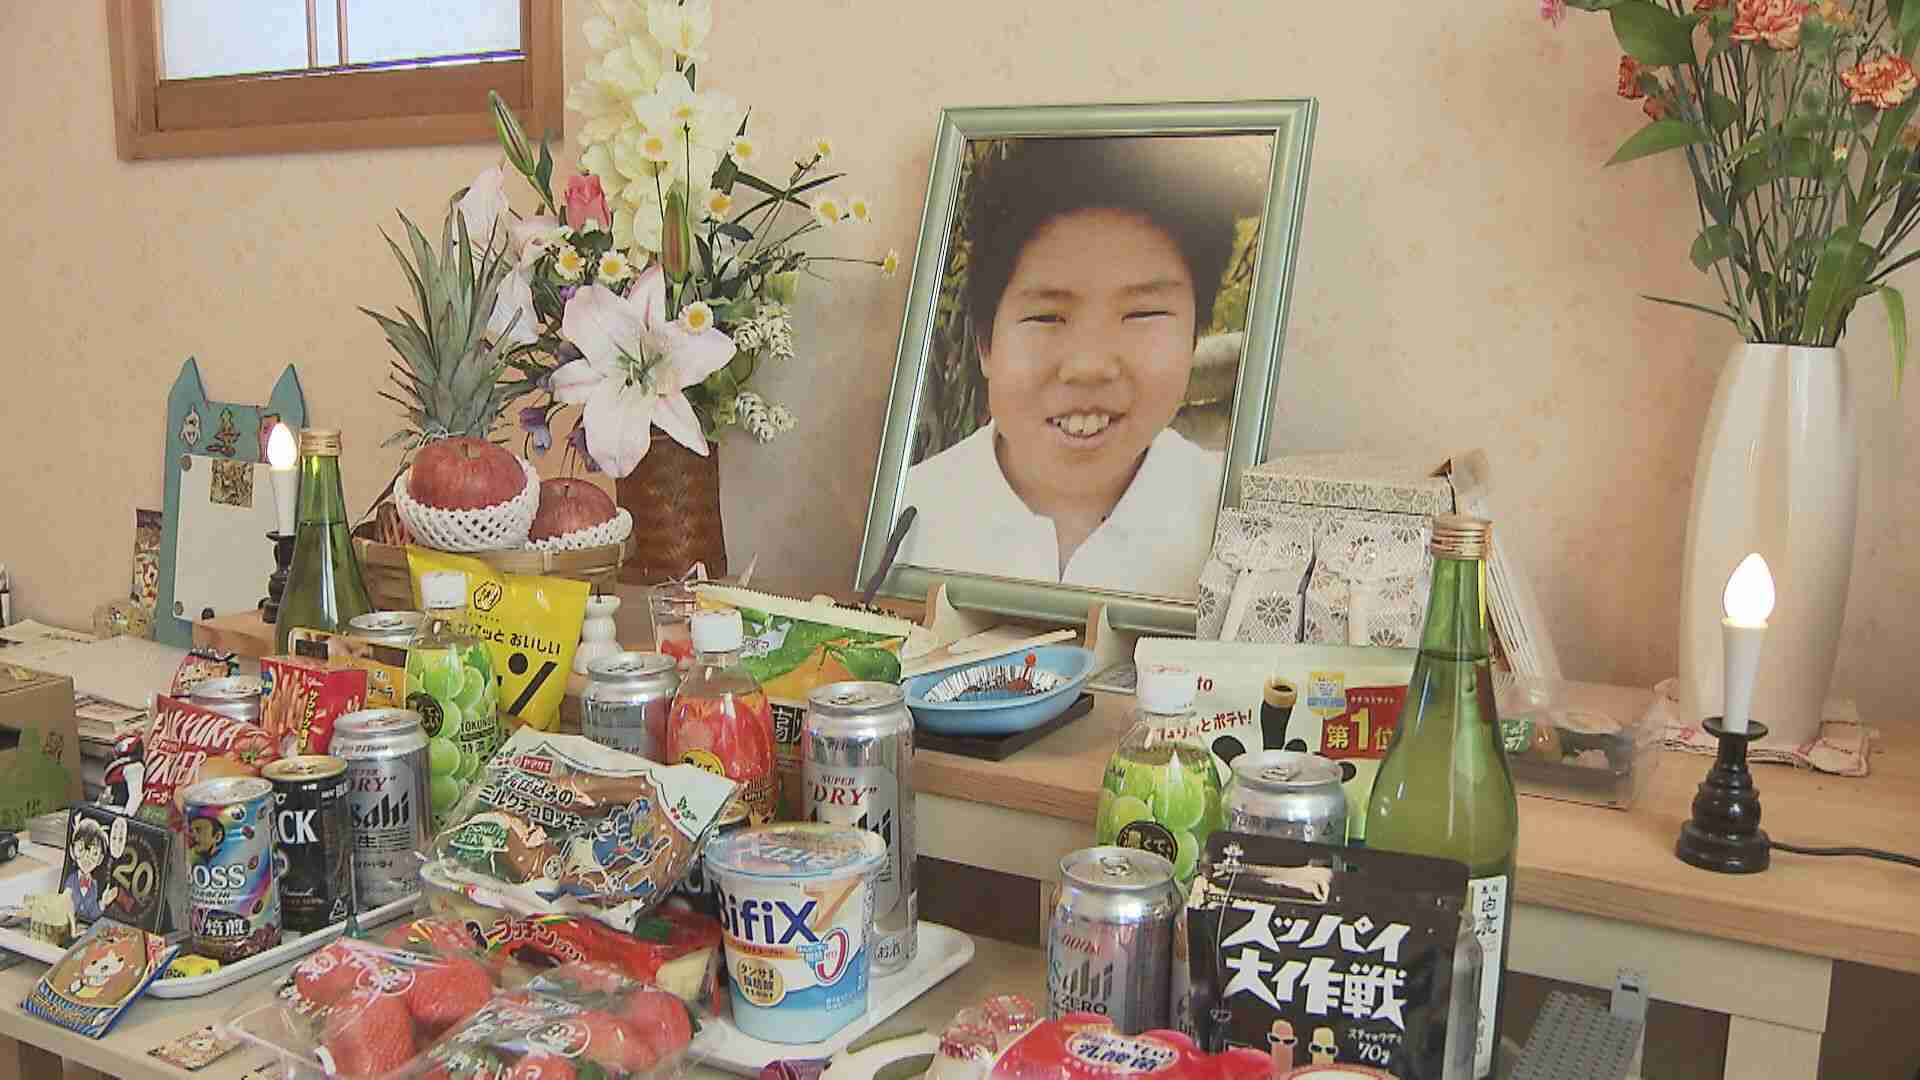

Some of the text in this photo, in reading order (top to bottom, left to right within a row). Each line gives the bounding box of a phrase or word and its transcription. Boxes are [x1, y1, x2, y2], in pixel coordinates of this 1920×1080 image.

[350, 792, 410, 829] sahi
[112, 848, 154, 899] 20
[1220, 900, 1412, 964] スッパイ
[1221, 946, 1409, 1032] 大作戦
[1358, 1042, 1391, 1065] 70g
